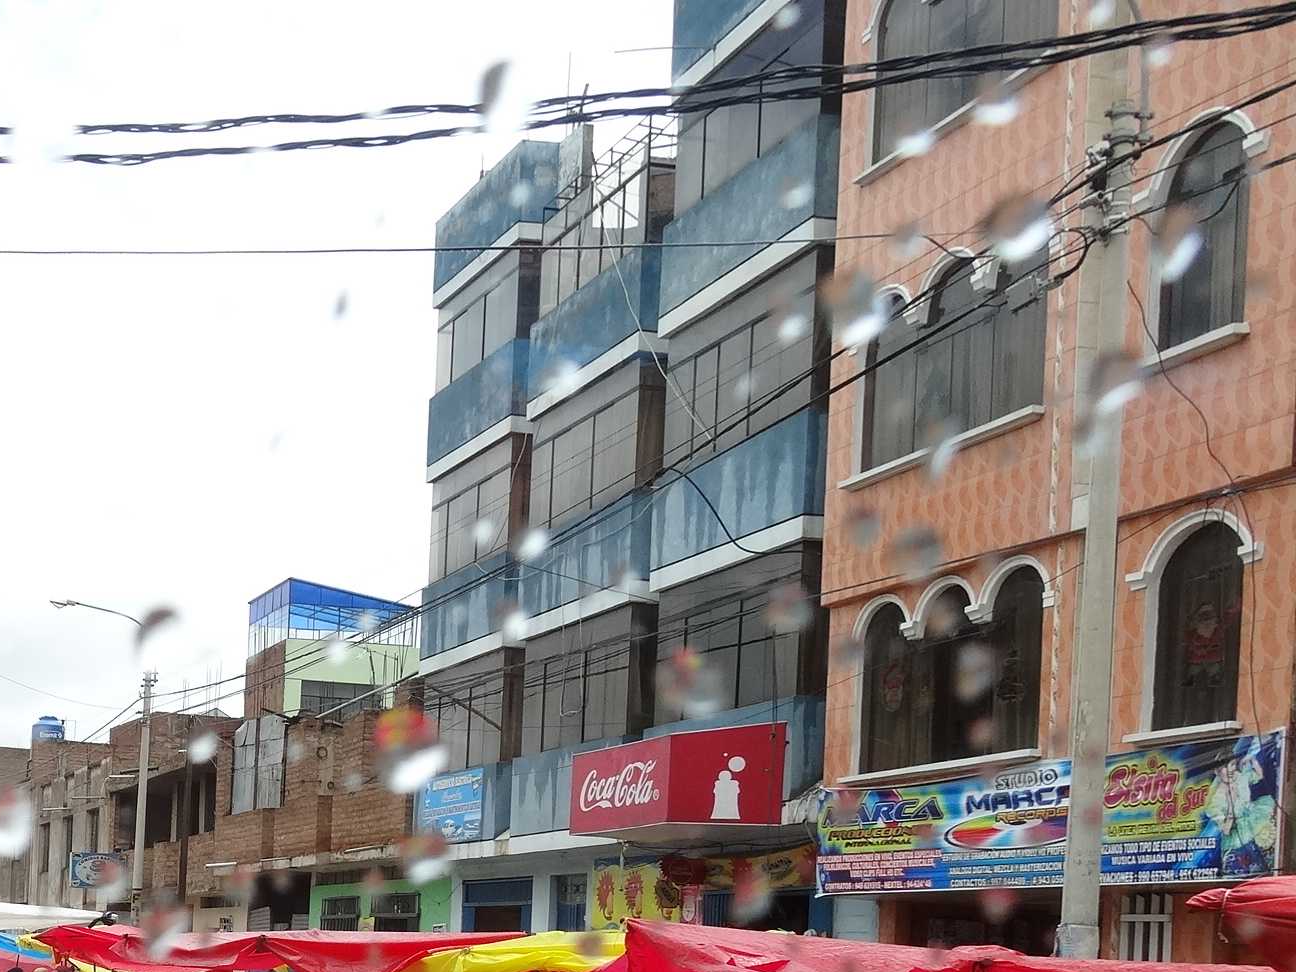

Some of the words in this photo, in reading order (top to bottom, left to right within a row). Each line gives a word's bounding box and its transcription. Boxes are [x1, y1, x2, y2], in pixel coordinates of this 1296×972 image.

[995, 768, 1059, 791] STUDIO
[1188, 837, 1217, 850] SOCIALES
[1112, 855, 1136, 866] MUSICA
[1166, 852, 1175, 863] EN
[1176, 852, 1194, 863] VIVO
